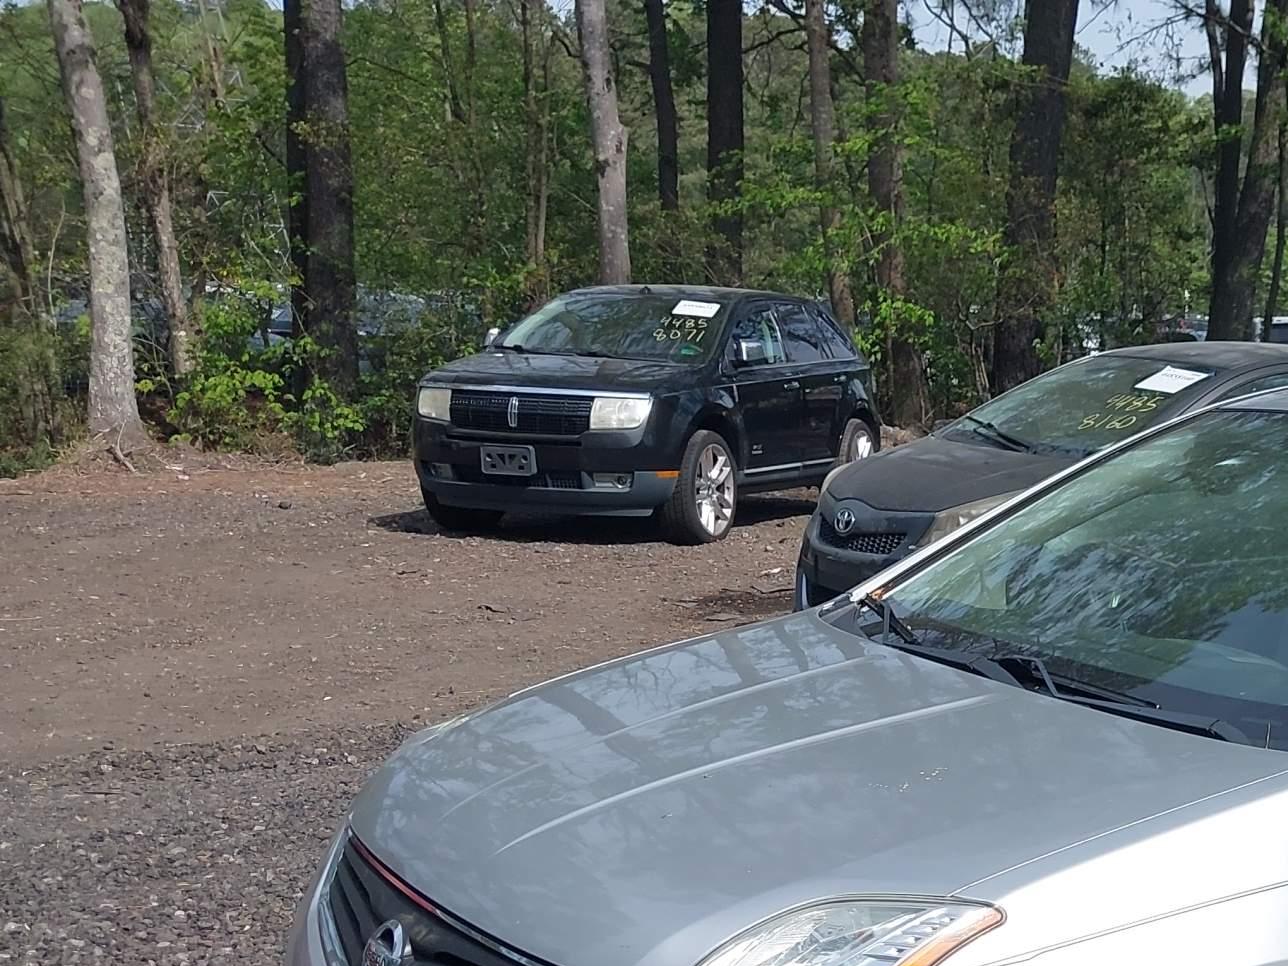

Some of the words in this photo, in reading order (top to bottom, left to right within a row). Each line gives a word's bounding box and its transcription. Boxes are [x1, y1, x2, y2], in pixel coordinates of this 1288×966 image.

[660, 316, 709, 329] 4485
[653, 328, 705, 342] 8071
[1105, 392, 1165, 413] 4485
[1077, 413, 1137, 430] 8160
